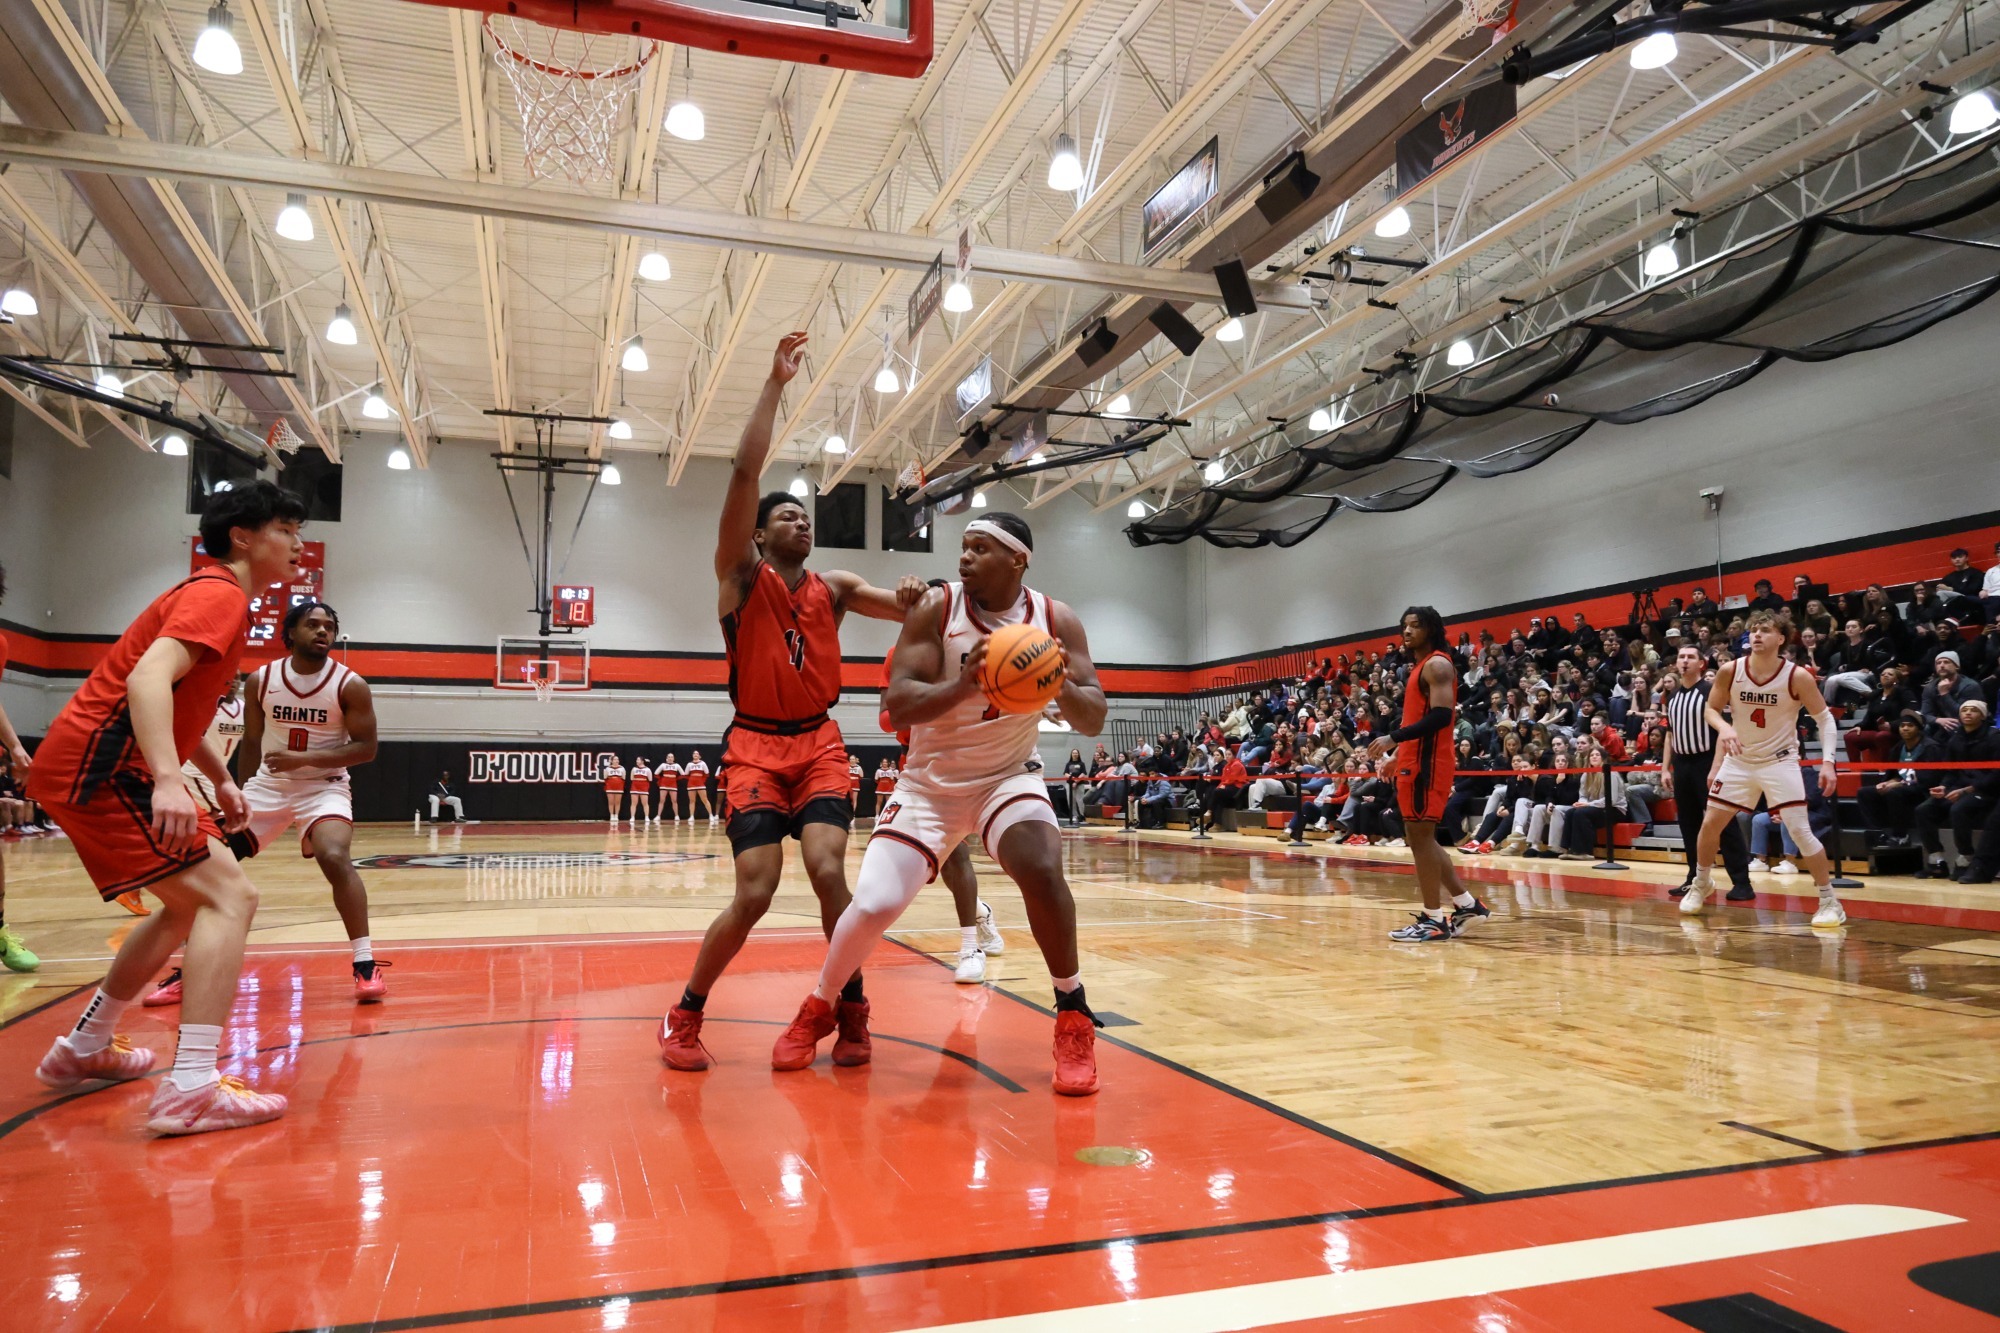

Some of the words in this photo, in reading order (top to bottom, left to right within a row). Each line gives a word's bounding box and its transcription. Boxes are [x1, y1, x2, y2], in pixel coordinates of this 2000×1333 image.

[291, 585, 314, 593] GUEST
[561, 588, 590, 600] 10:13
[569, 602, 586, 621] 18
[784, 628, 805, 673] 11
[1011, 638, 1054, 671] Wilson
[1750, 708, 1766, 728] 4
[287, 727, 309, 752] 0
